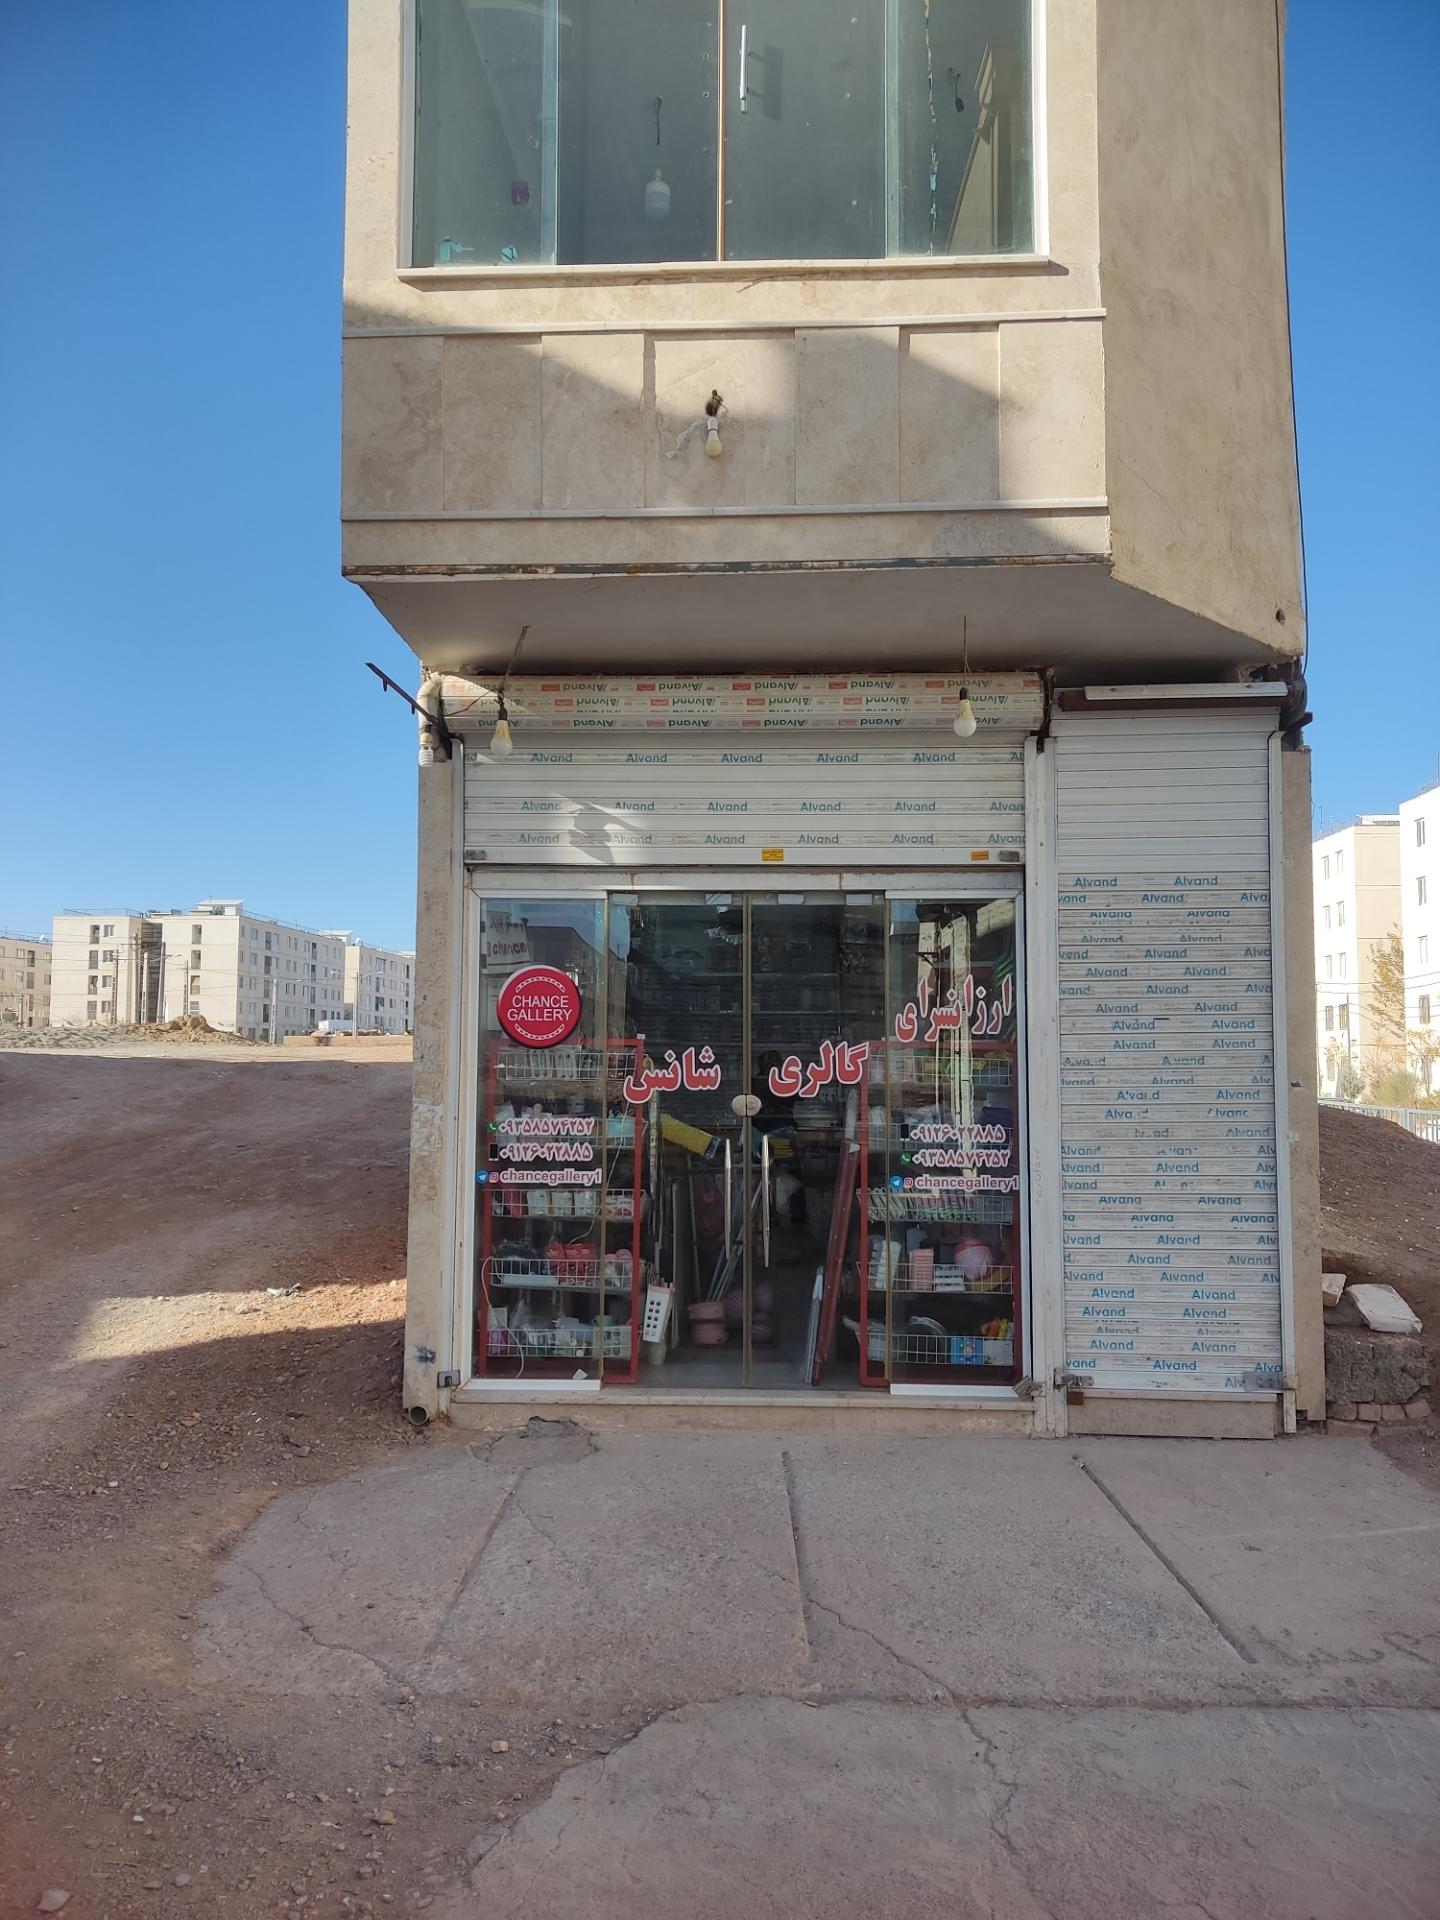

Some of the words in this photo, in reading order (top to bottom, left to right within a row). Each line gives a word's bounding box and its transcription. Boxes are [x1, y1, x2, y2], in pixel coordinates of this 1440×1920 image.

[530, 752, 574, 763] Alvand
[626, 752, 668, 763] Alvand
[720, 752, 763, 763] Alvand
[816, 752, 859, 762] Alvand
[912, 752, 956, 762] Alvand
[614, 800, 656, 812] Alvand
[706, 801, 748, 812] Alvand
[800, 802, 842, 812] Alvand
[894, 801, 936, 812] Alvand
[518, 833, 559, 844] Alvand
[704, 834, 746, 844] Alvand
[798, 834, 839, 844] Alvand
[892, 834, 934, 844] Alvand
[1074, 876, 1118, 888] Alvand
[1174, 876, 1218, 886] Alvand
[1140, 893, 1184, 903] Alvand
[1144, 948, 1188, 959] Alvand
[1085, 966, 1128, 978] Alvand
[1184, 966, 1227, 976] Alvand
[1146, 984, 1190, 995] Alvand
[512, 995, 569, 1007] CHANCE
[895, 974, 1012, 1042] ارزانسرای
[1096, 1002, 1138, 1014] Alvand
[1194, 1002, 1238, 1012] Alvand
[507, 1008, 573, 1021] GALLERY
[1112, 1020, 1155, 1030] Alvand
[1211, 1018, 1255, 1030] Alvand
[1112, 1040, 1156, 1050] Alvand
[1212, 1038, 1256, 1049] Alvand
[623, 1046, 721, 1103] شانس
[769, 1041, 869, 1097] گالری
[1216, 1089, 1260, 1100] Alvand
[1156, 1162, 1200, 1173] Alvand
[500, 1168, 602, 1186] chancegallery1
[914, 1174, 1019, 1192] chancegallery1
[1156, 1234, 1200, 1245] Alvand
[1128, 1254, 1170, 1264] Alvand
[1228, 1255, 1272, 1266] Alvand
[1160, 1272, 1204, 1282] Alvand
[1091, 1288, 1135, 1298] Alvand
[1192, 1290, 1236, 1300] Alvand
[1082, 1306, 1126, 1316] Alvand
[1183, 1308, 1226, 1318] Alvand
[1090, 1340, 1134, 1350] Alvand
[1192, 1342, 1236, 1352] Alvand
[1153, 1360, 1197, 1370] Alvand
